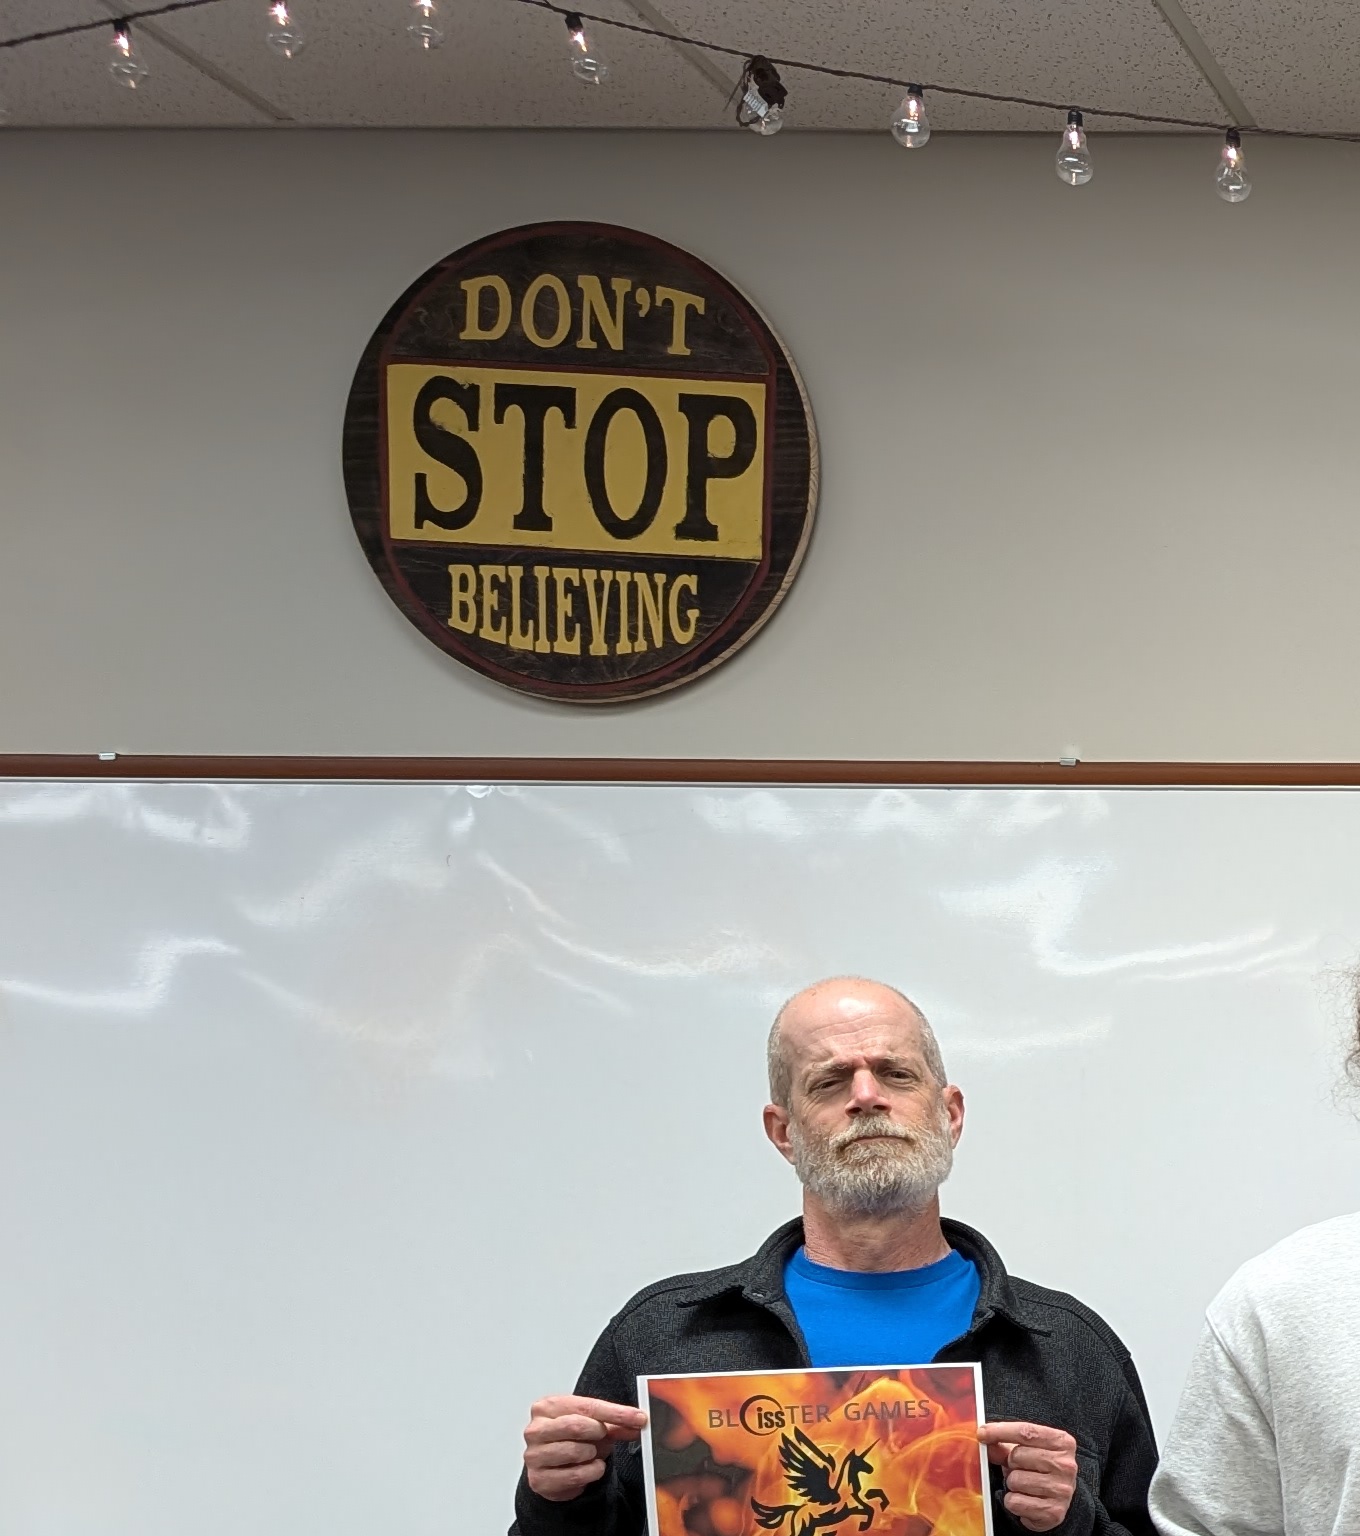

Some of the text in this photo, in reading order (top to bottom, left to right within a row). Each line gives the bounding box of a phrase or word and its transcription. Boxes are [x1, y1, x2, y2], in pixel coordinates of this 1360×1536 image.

[459, 274, 705, 356] DON'T
[413, 375, 758, 541] STOP
[447, 564, 699, 656] BELIEVING
[843, 1398, 931, 1423] GAMES
